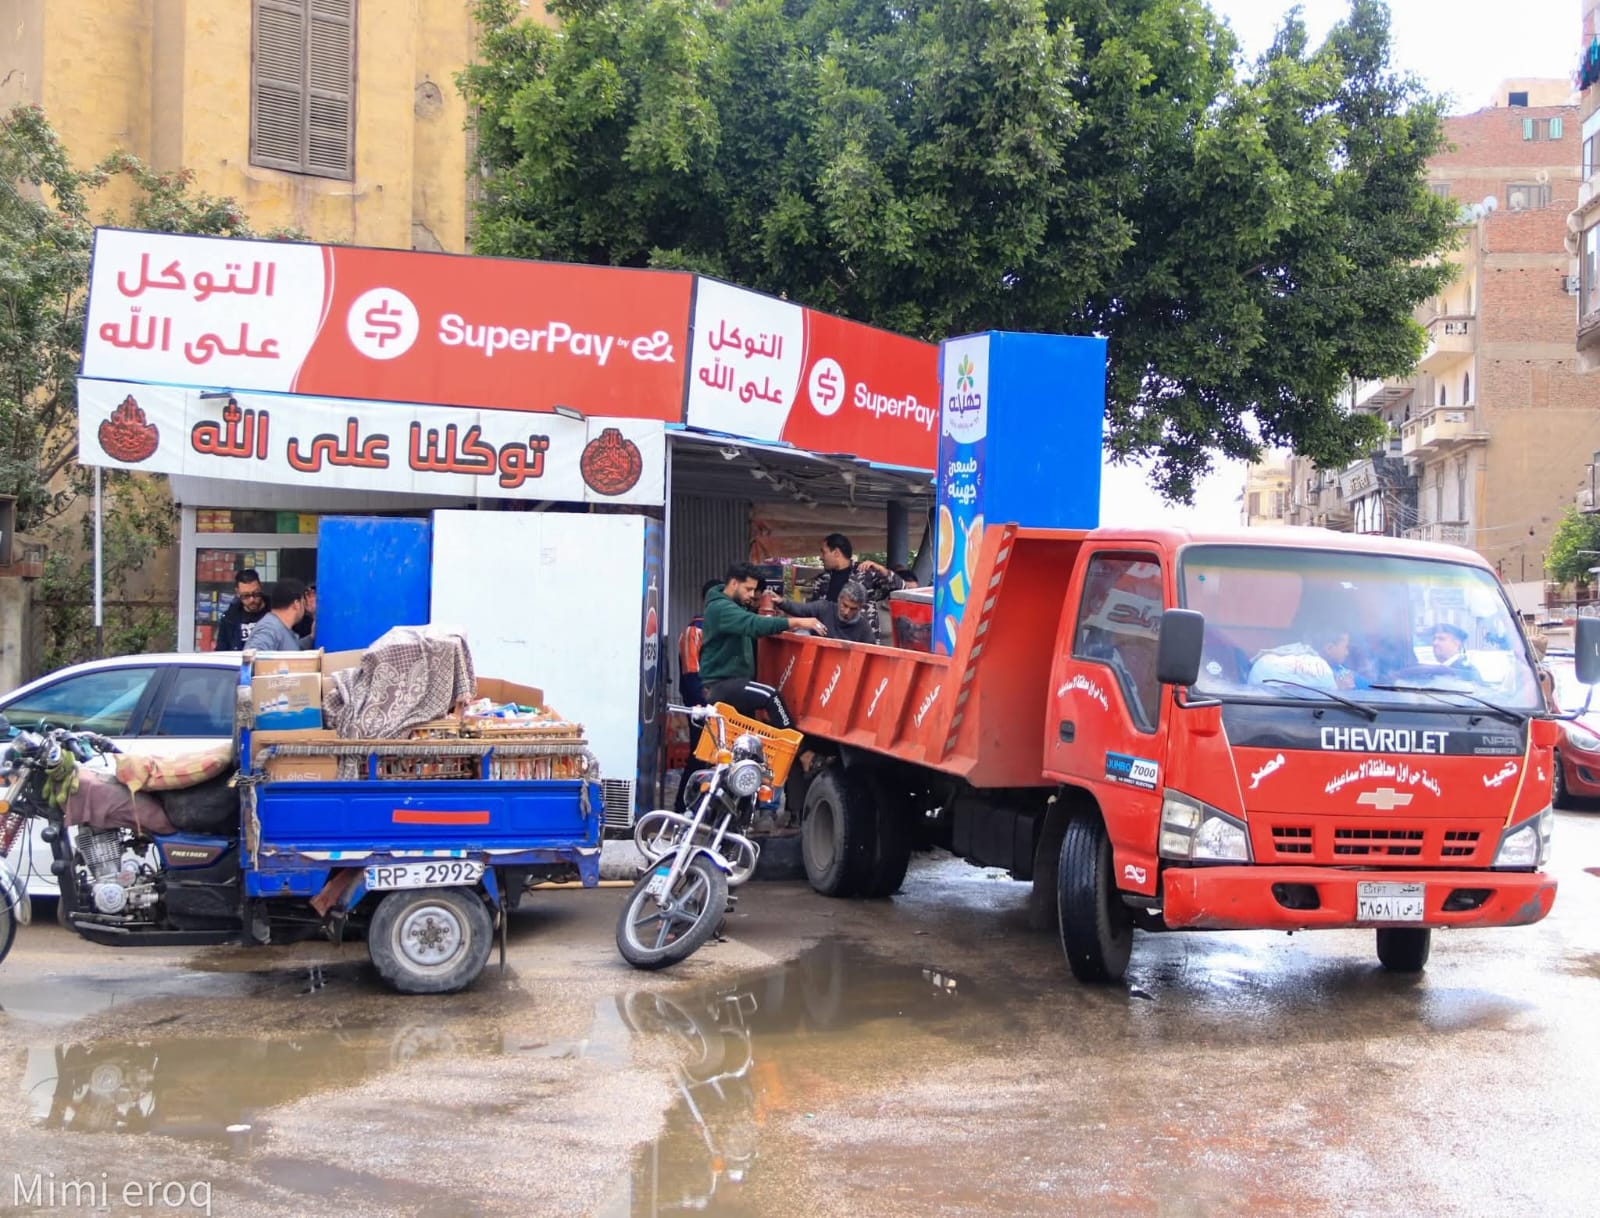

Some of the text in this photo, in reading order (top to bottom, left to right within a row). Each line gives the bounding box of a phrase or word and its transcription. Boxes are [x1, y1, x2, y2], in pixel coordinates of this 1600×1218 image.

[117, 252, 276, 302] التوكل
[184, 322, 280, 365] على
[439, 313, 614, 366] SuperPay
[616, 337, 630, 348] by
[708, 318, 783, 360] التوكل
[739, 376, 782, 404] على
[854, 382, 936, 432] SuperPay
[287, 416, 390, 473] على
[408, 420, 550, 489] توكلنا
[1320, 726, 1450, 754] CHEVROLET
[1482, 735, 1516, 746] NPR
[1134, 764, 1156, 778] 7000
[1248, 752, 1286, 789] مصر
[1482, 760, 1518, 788] تحيا
[377, 868, 407, 887] RP
[424, 862, 475, 884] 2992
